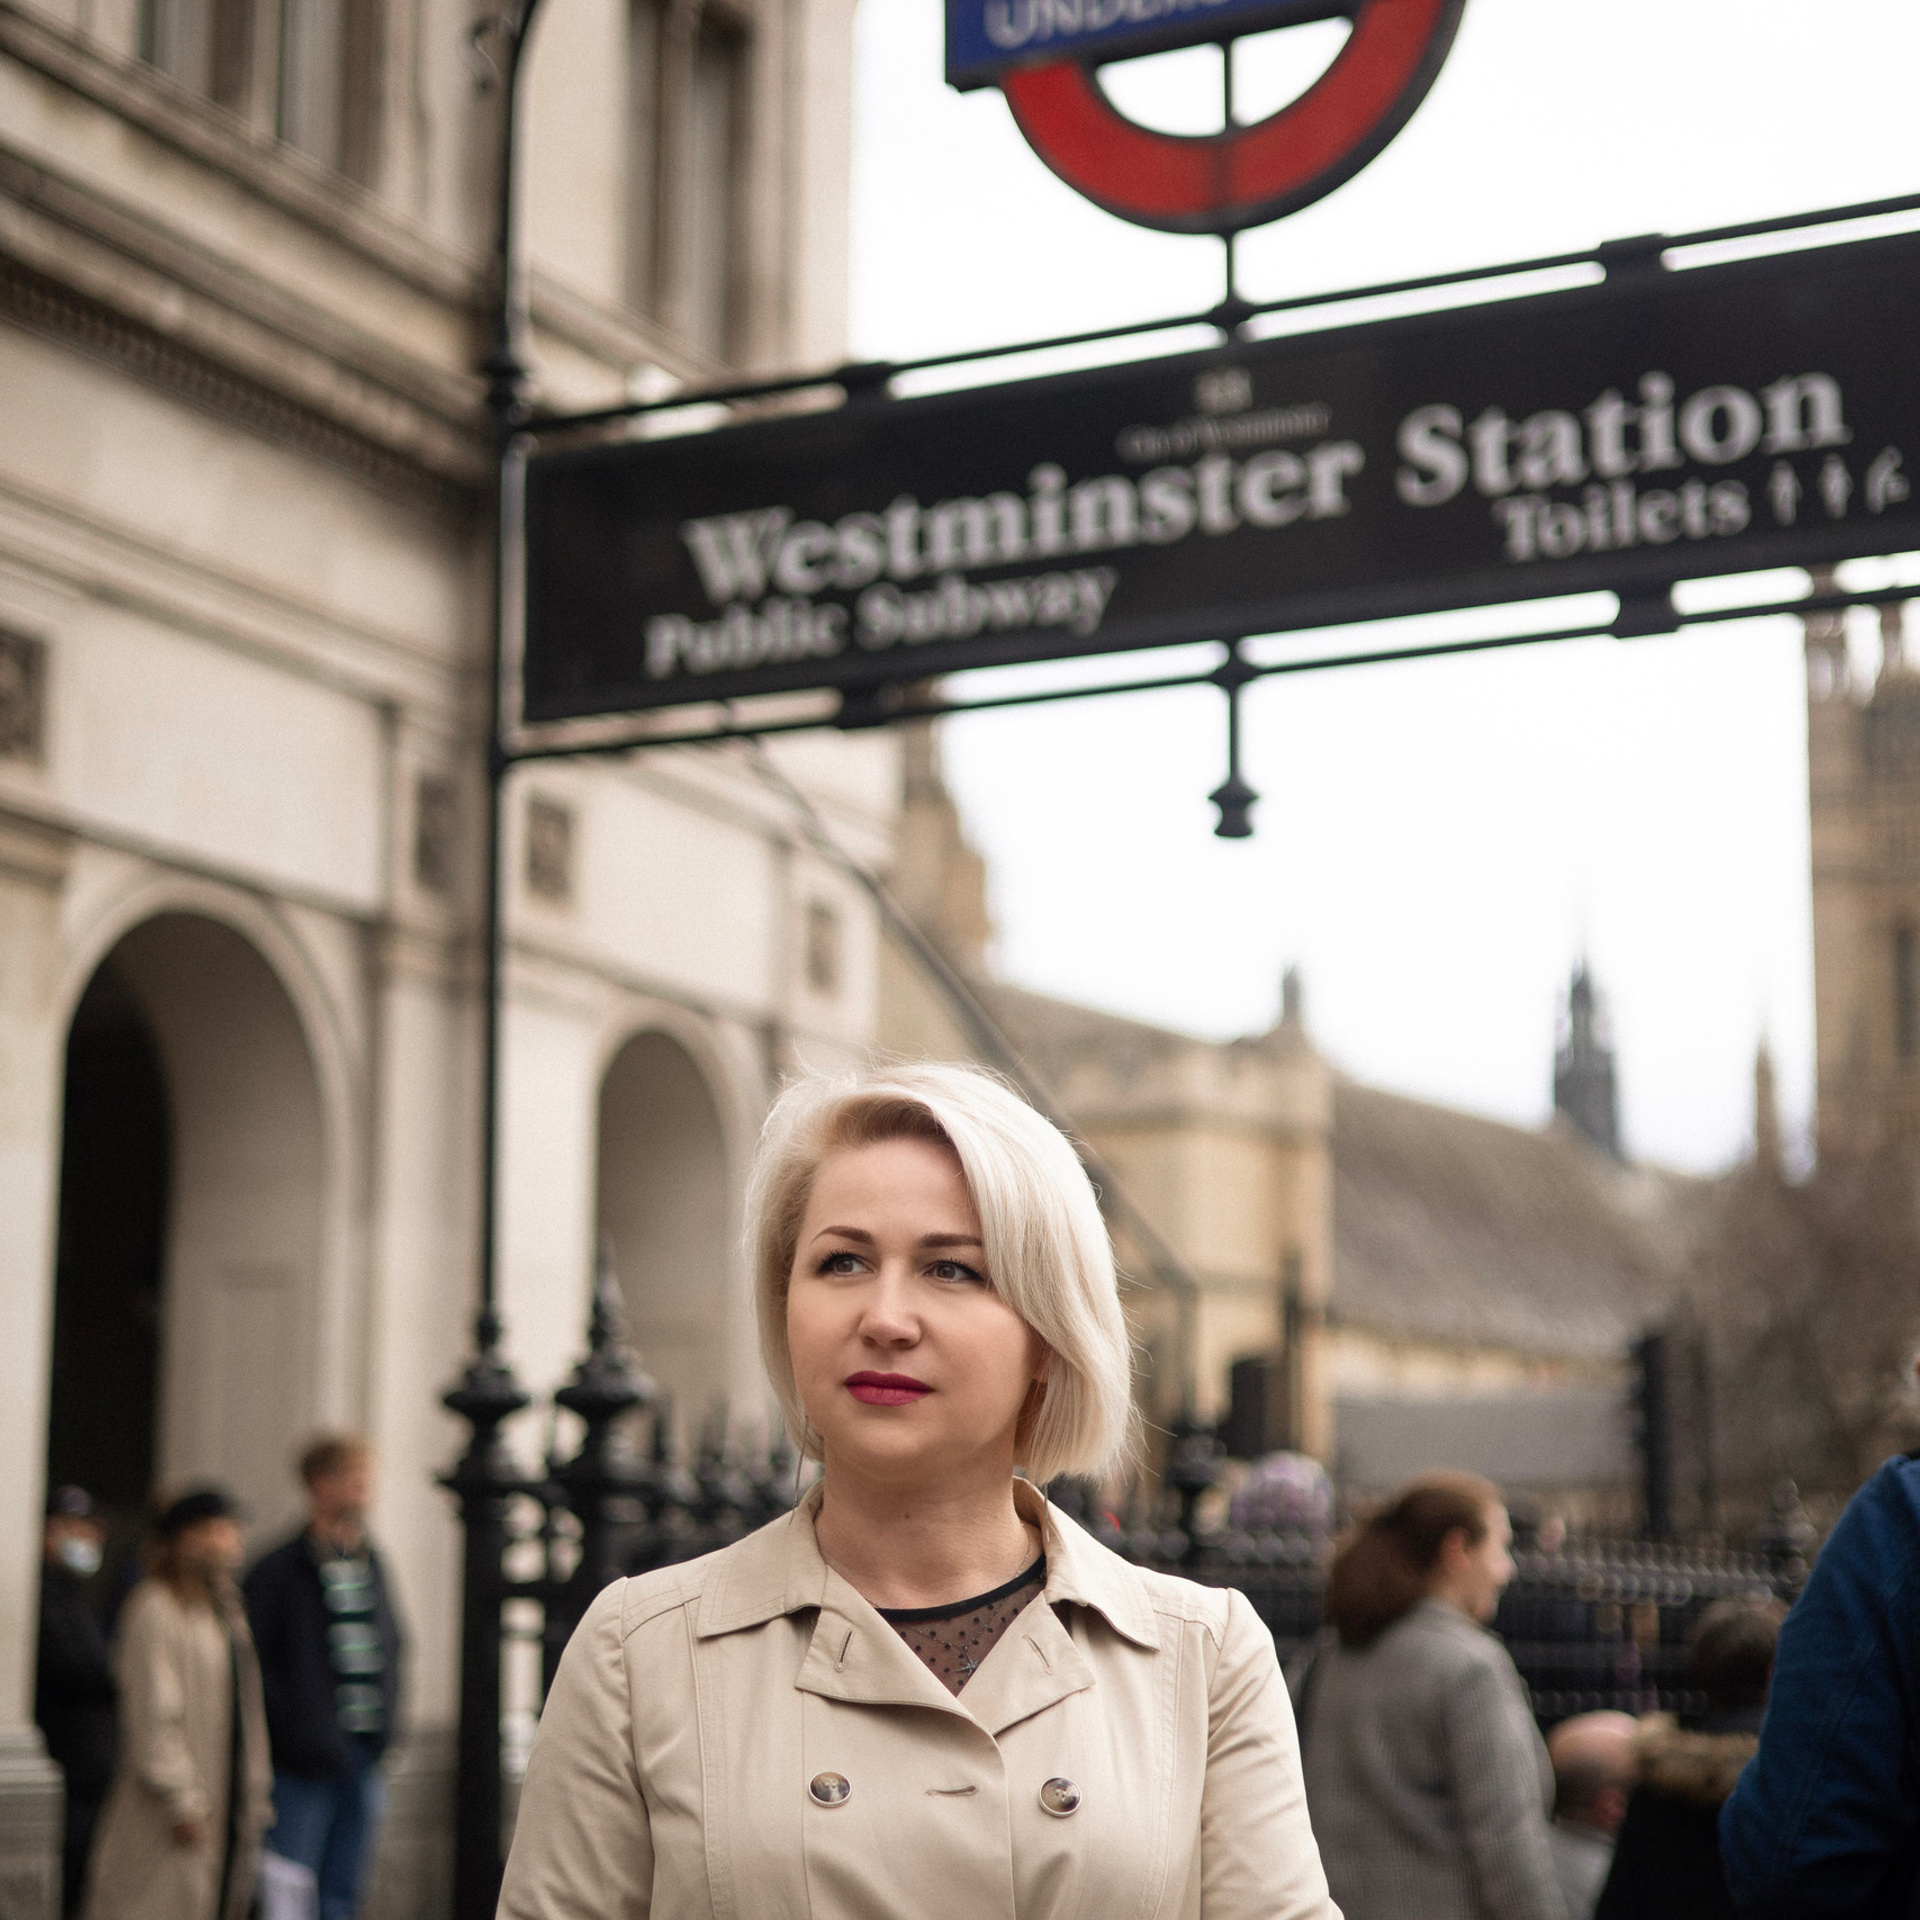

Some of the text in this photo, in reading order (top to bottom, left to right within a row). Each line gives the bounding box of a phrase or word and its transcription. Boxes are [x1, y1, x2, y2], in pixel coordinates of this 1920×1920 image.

[684, 440, 1365, 601] Westminster
[1397, 372, 1850, 507] Station
[1494, 480, 1750, 562] Toilets
[645, 568, 1117, 680] Public Subway
